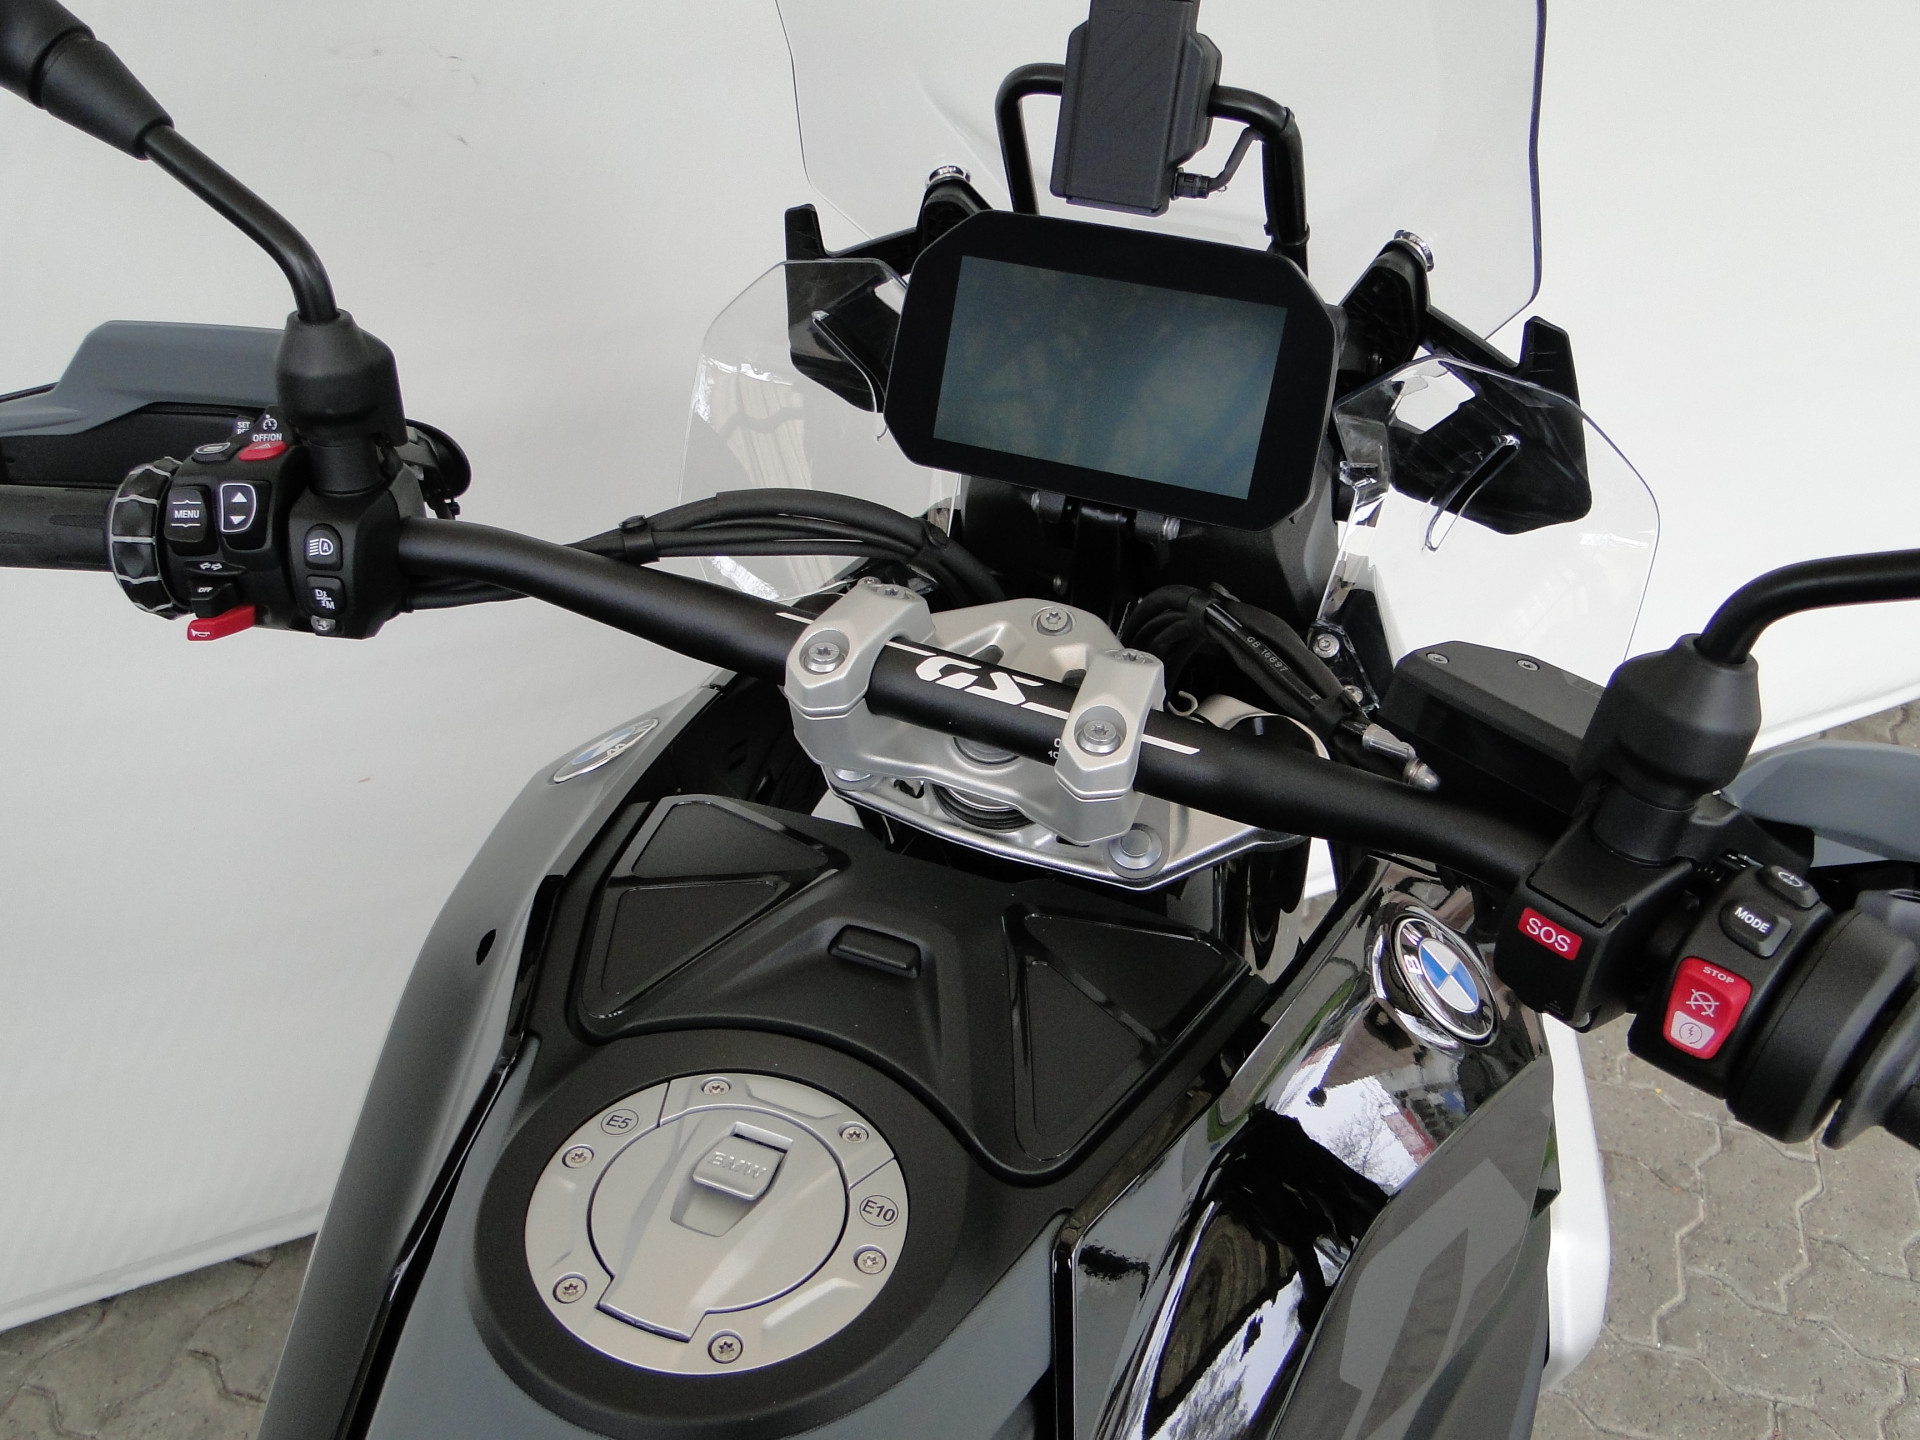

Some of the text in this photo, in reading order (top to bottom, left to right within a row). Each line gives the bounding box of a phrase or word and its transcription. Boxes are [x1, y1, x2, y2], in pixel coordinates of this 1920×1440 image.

[237, 421, 251, 429] SET
[252, 433, 283, 442] OFF/ON
[174, 509, 200, 519] MENU
[1261, 649, 1289, 672] 16897
[916, 655, 1044, 706] GS
[1733, 906, 1770, 935] MODE
[1525, 917, 1572, 952] SOS
[1702, 966, 1735, 985] STOP
[605, 1113, 633, 1131] E5
[708, 1151, 768, 1180] BMW
[862, 1199, 896, 1222] E10
